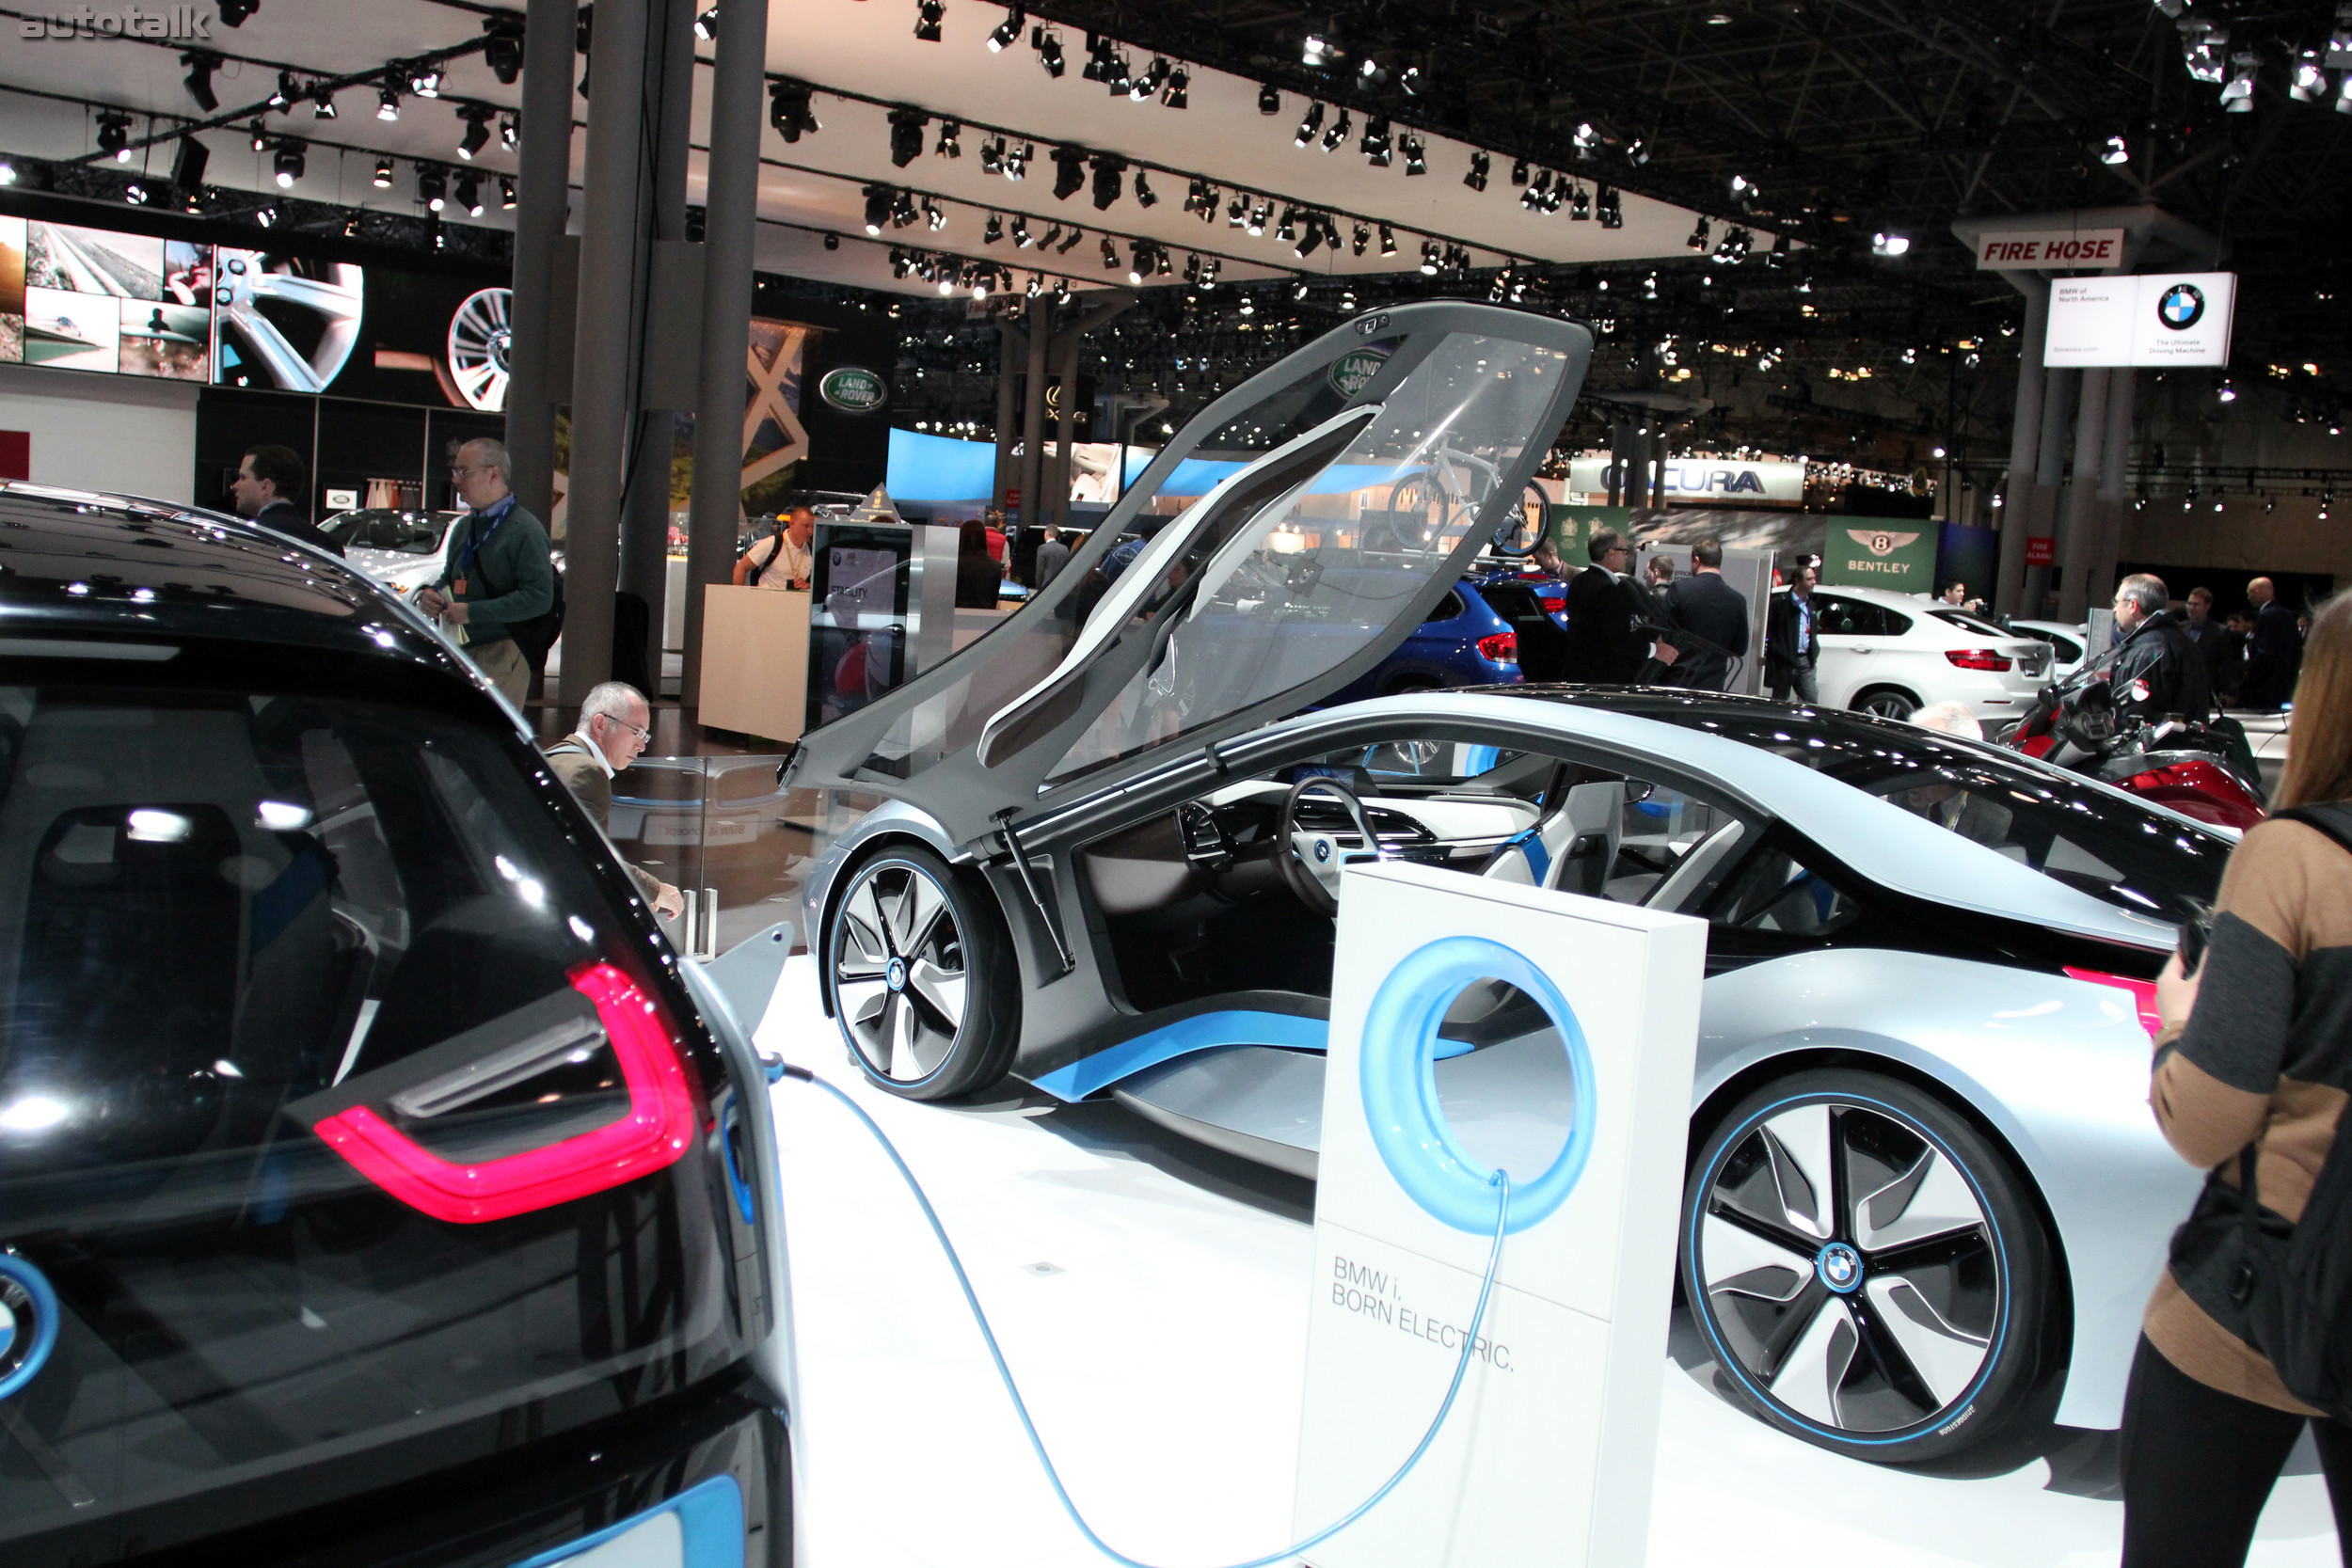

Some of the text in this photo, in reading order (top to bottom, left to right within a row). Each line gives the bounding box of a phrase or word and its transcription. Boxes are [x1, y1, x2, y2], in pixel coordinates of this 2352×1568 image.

[1984, 239, 2114, 261] FIRE HOSE
[1344, 357, 1382, 375] LAND
[839, 377, 867, 389] LAND
[840, 388, 875, 402] ROVER
[1635, 467, 1766, 495] CURA
[1874, 536, 1889, 550] B
[1849, 560, 1911, 574] BENTLEY
[1334, 1256, 1402, 1301] BMW i.
[1332, 1282, 1514, 1372] BORN ELECTRIC.
